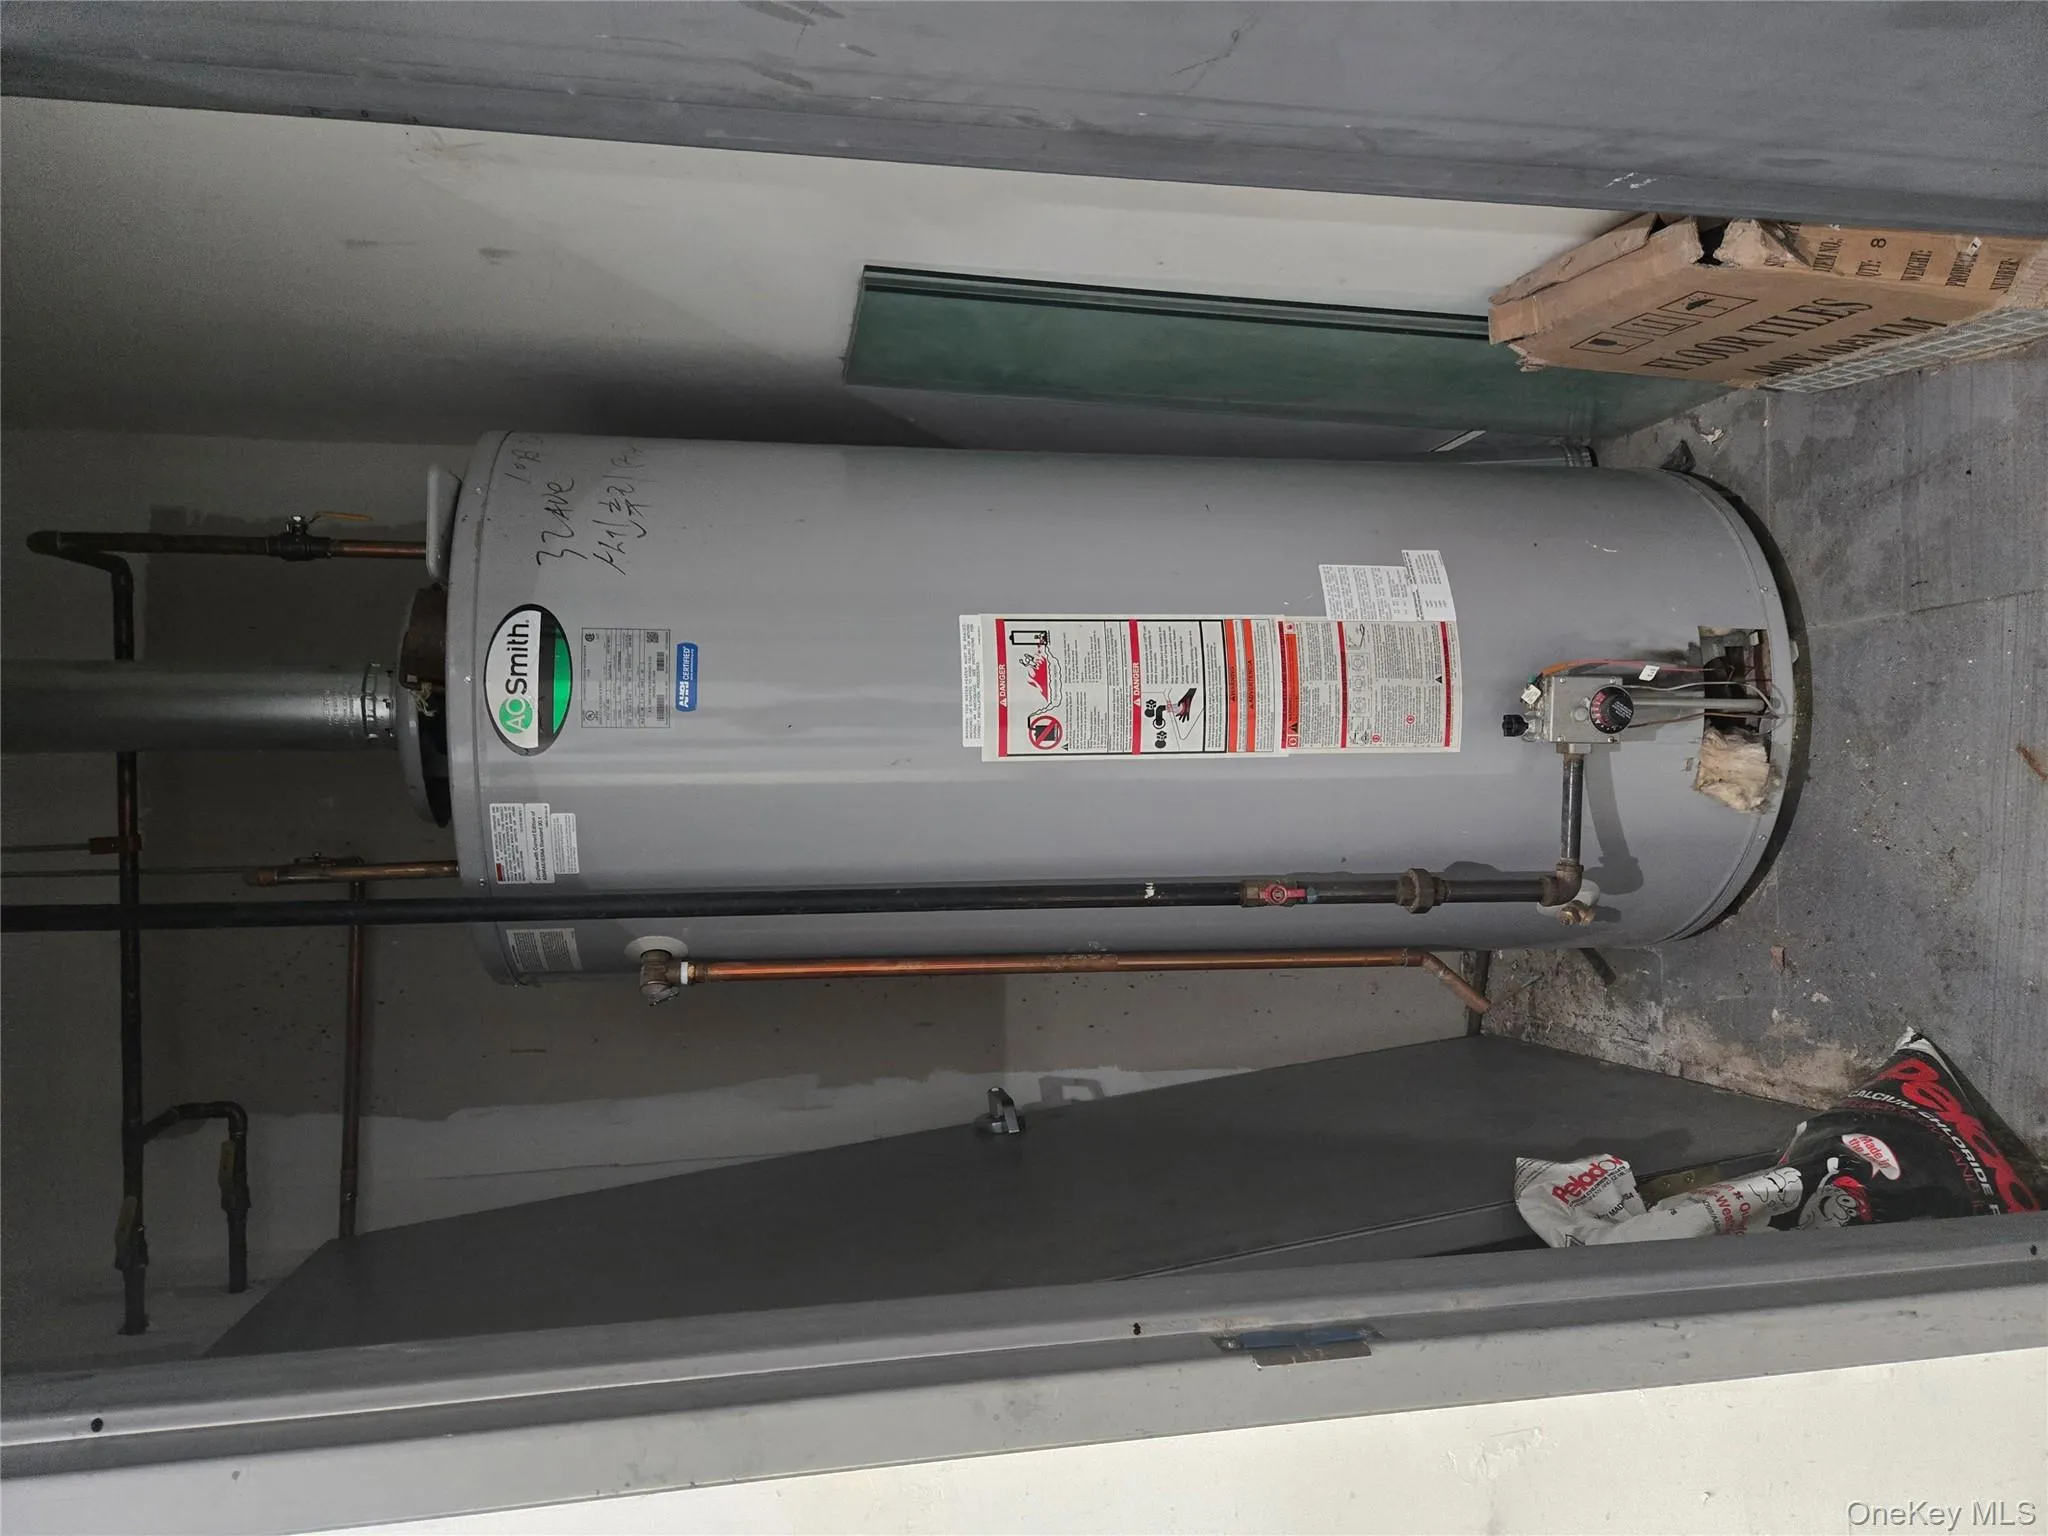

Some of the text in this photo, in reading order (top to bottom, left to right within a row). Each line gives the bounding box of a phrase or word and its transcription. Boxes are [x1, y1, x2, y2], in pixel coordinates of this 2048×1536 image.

[1871, 238, 1887, 249] 8
[1640, 298, 1872, 372] FLOOR TILES
[683, 647, 691, 680] CERTIFIED
[1848, 1090, 1918, 1111] CALCIUM
[1918, 1111, 1994, 1196] CHLORIDE
[1848, 1138, 1866, 1156] the
[1859, 1135, 1885, 1160] Made
